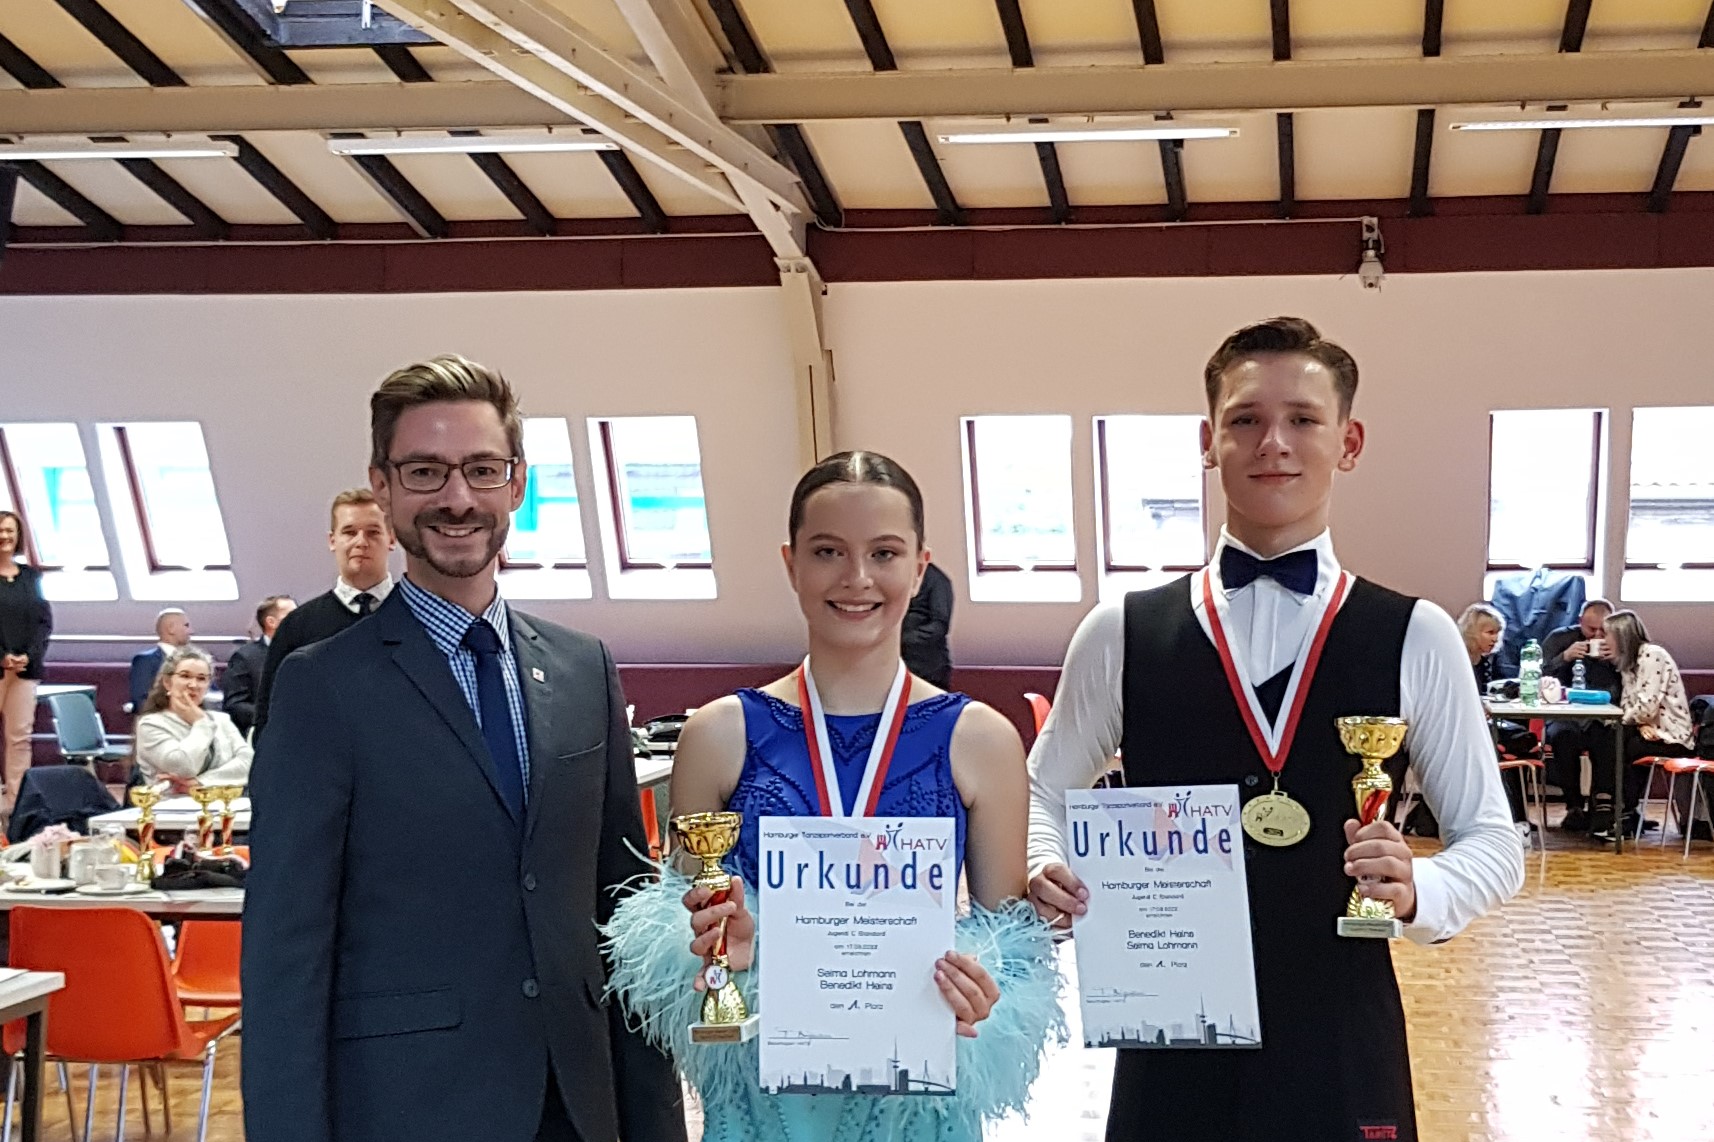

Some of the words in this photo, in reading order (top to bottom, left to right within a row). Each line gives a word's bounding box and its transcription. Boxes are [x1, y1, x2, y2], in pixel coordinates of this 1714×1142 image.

[1190, 804, 1233, 818] HATV
[1073, 818, 1232, 858] Urkunde
[900, 838, 948, 851] HATV
[766, 850, 943, 890] Urkunde
[1101, 881, 1150, 891] Hamburger
[795, 915, 850, 926] Hamburger
[853, 916, 918, 926] Meisterschaft
[1128, 930, 1166, 939] Benedikt
[1157, 941, 1199, 949] Lohmann
[851, 969, 897, 979] Lohmann
[820, 980, 862, 990] Benedikt
